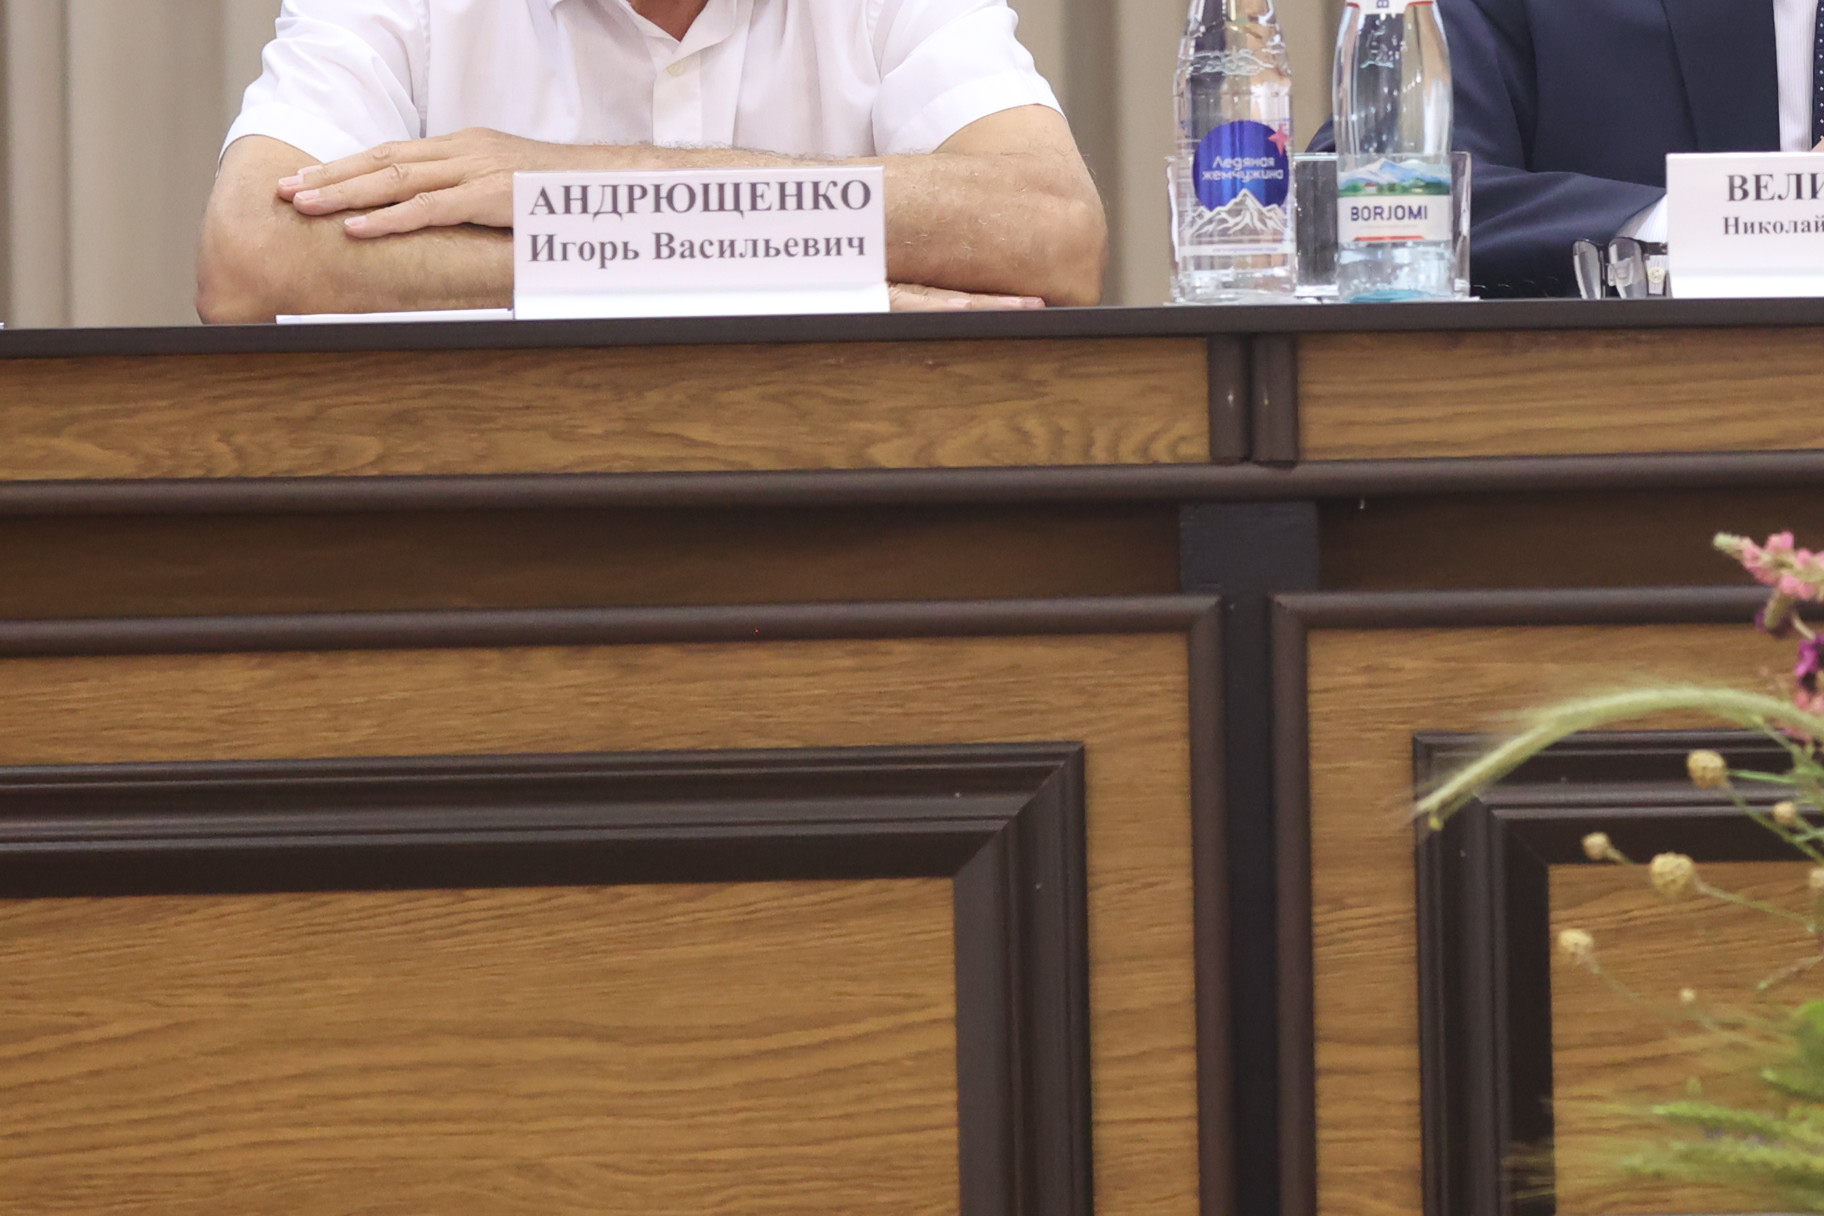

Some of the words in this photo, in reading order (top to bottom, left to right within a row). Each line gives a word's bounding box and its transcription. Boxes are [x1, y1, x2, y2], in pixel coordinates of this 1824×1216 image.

[1212, 155, 1276, 170] Ледяная
[1202, 168, 1285, 183] жемчужина
[528, 179, 873, 222] АНДРЮЩЕНКО
[1350, 204, 1428, 222] BORJOMI
[527, 233, 640, 270] Игорь
[651, 231, 867, 262] Васильевич
